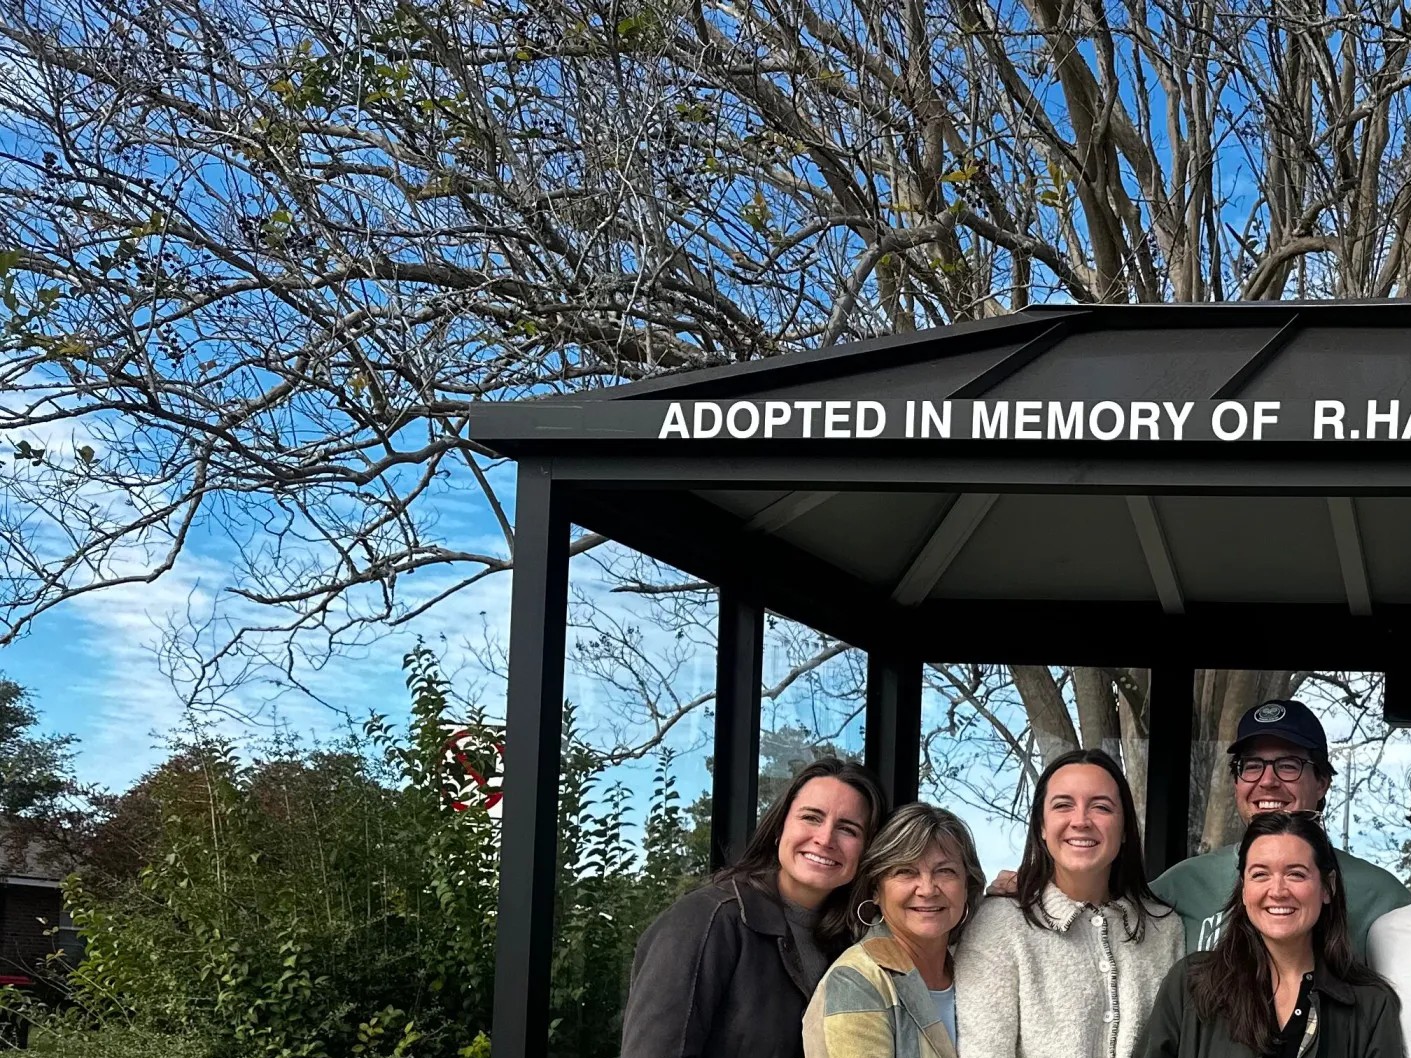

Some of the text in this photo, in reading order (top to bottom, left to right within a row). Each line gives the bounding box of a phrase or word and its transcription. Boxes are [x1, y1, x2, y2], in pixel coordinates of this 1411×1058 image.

[658, 400, 886, 439] ADOPTED
[905, 400, 952, 439] IN
[971, 400, 1195, 441] MEMORY
[1211, 400, 1281, 441] OF
